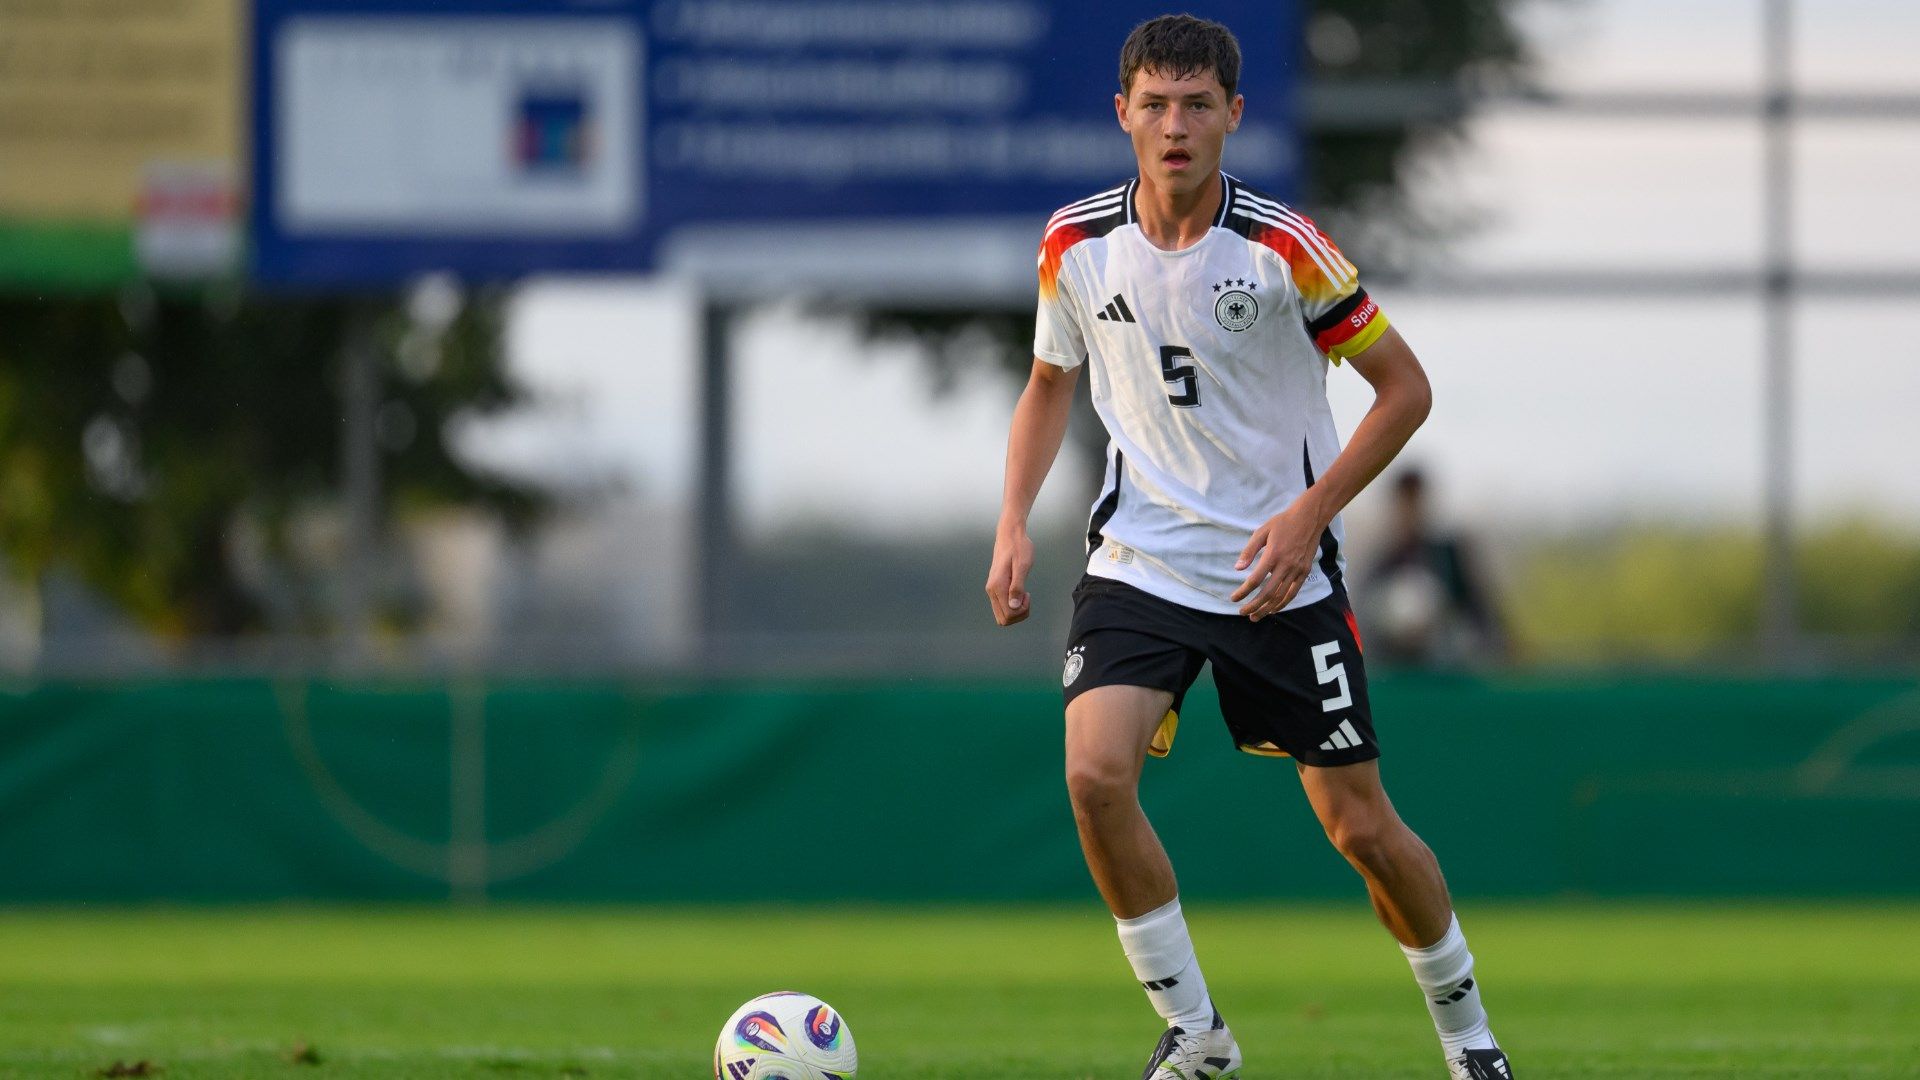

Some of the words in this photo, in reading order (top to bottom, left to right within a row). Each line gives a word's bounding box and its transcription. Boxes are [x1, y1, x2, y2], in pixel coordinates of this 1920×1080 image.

[1350, 298, 1378, 328] Spiel
[1159, 345, 1202, 408] 5
[1310, 639, 1353, 713] 5
